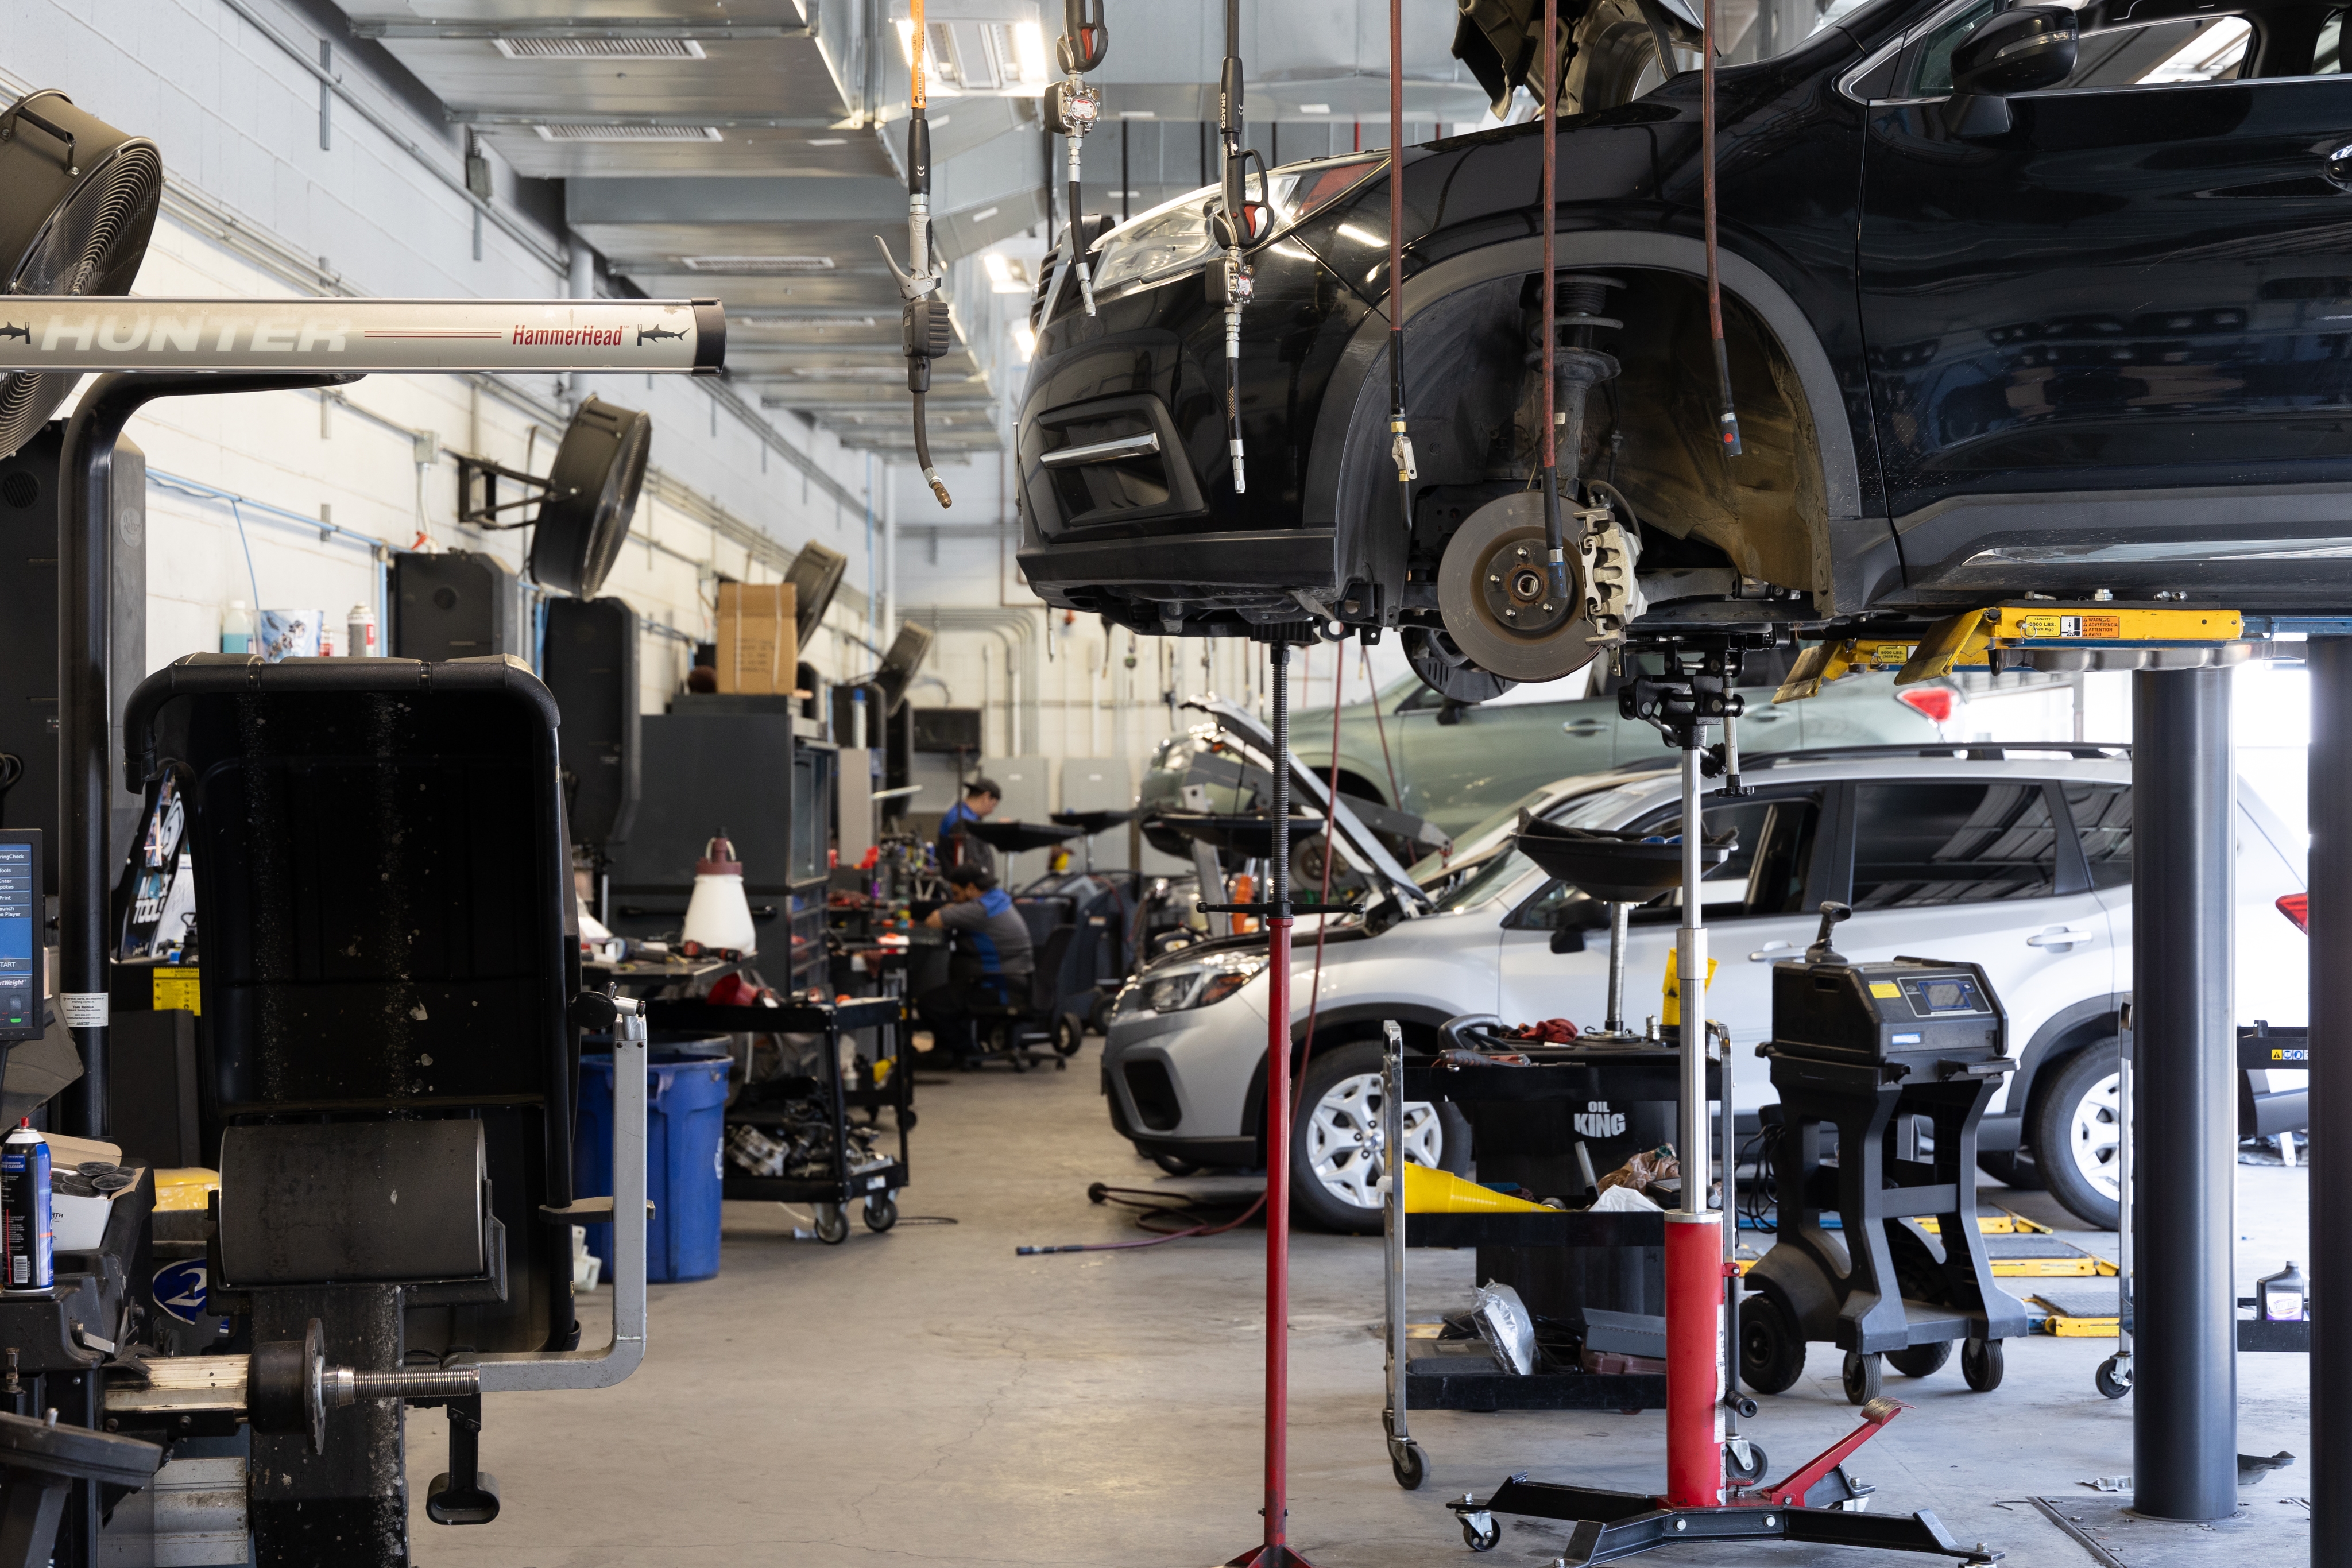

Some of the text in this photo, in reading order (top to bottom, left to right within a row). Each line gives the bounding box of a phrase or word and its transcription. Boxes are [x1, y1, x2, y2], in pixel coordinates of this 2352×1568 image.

[41, 314, 350, 351] HUNTER
[513, 325, 623, 346] HammerHead
[1588, 1101, 1610, 1112] OIL
[1574, 1113, 1626, 1137] KING
